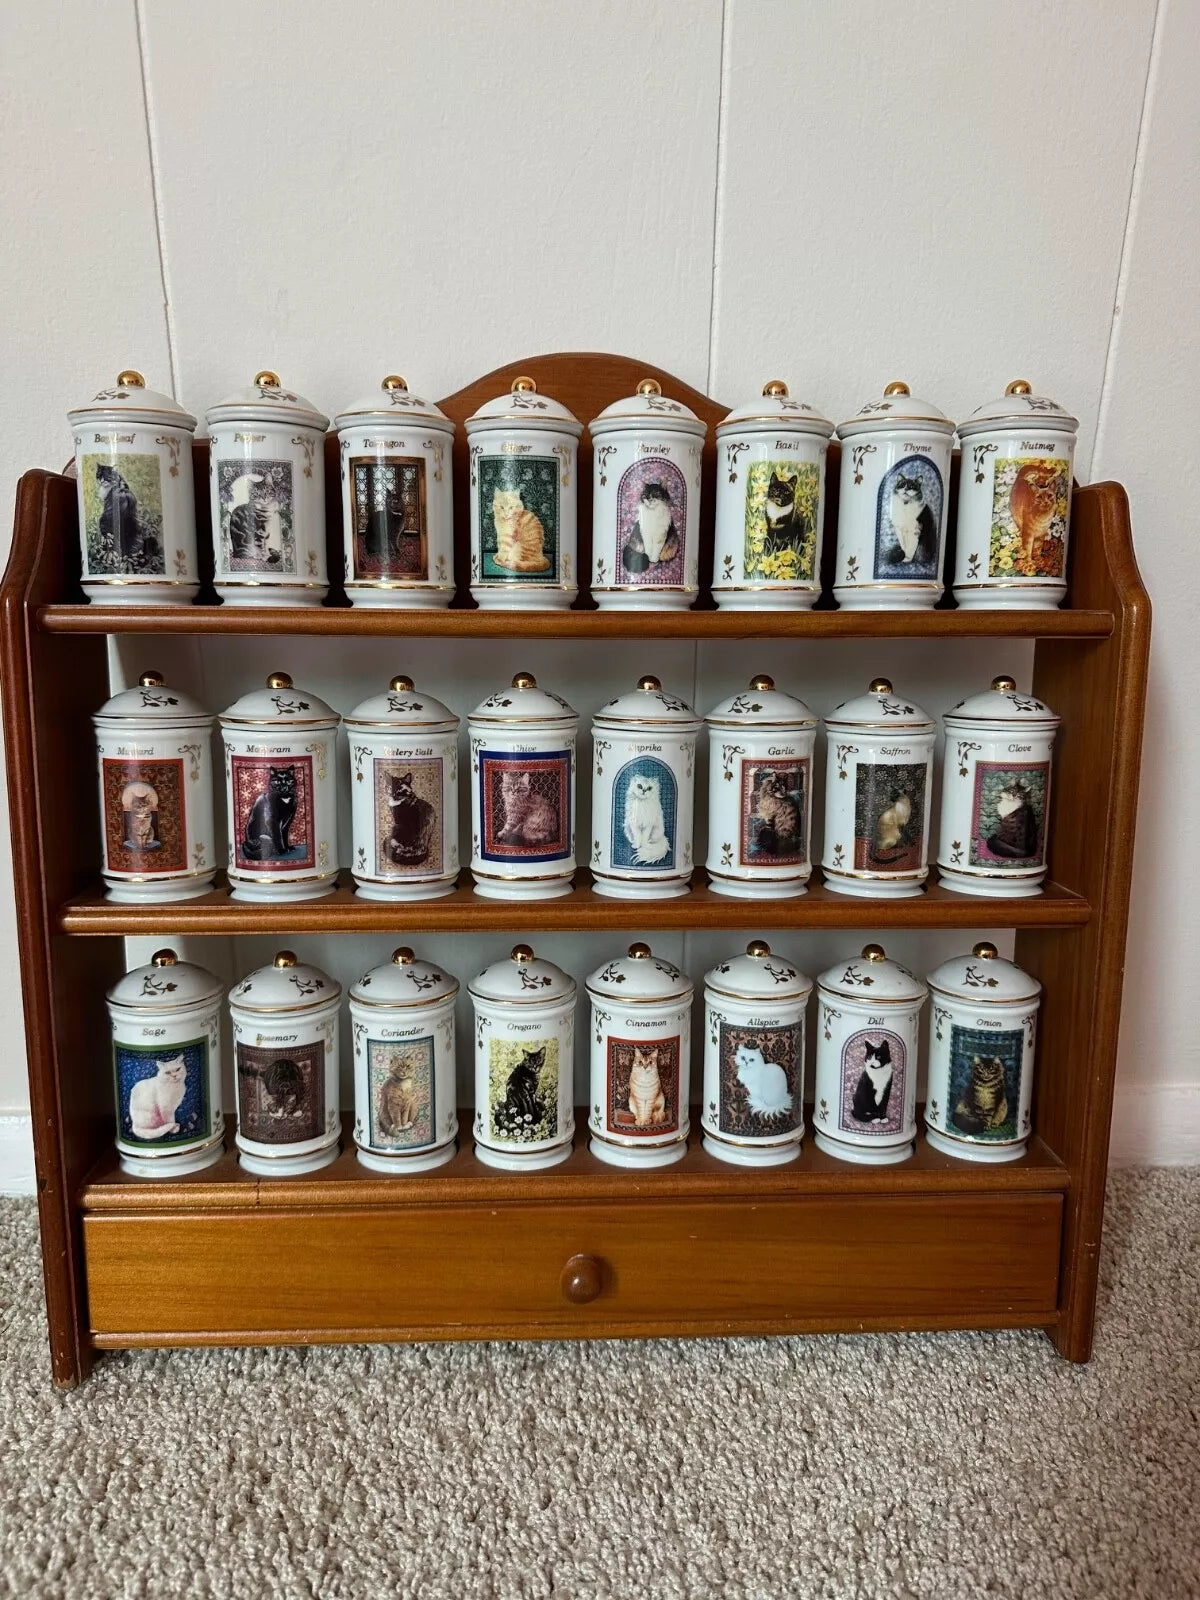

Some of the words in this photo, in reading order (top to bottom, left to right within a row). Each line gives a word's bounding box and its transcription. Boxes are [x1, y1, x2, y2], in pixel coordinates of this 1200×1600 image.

[363, 438, 406, 450] Taagon
[774, 440, 800, 450] Basil
[904, 442, 932, 454] Thyme
[1020, 441, 1056, 452] Nutmeg
[117, 746, 154, 756] Muard
[246, 744, 291, 754] Maram
[415, 748, 433, 756] Salt
[512, 743, 538, 753] Chive
[628, 743, 662, 754] aprika
[768, 746, 796, 756] Garlic
[880, 746, 911, 756] Saffron
[1008, 744, 1032, 753] Clove
[626, 1018, 667, 1028] Cinnamon
[747, 1018, 780, 1028] Allspice
[867, 1017, 885, 1026] Dill
[976, 1018, 1002, 1028] Onion
[381, 1026, 425, 1038] Coriander
[507, 1022, 542, 1032] Oregano
[142, 1027, 166, 1038] Sage
[256, 1033, 298, 1043] Rosemary
